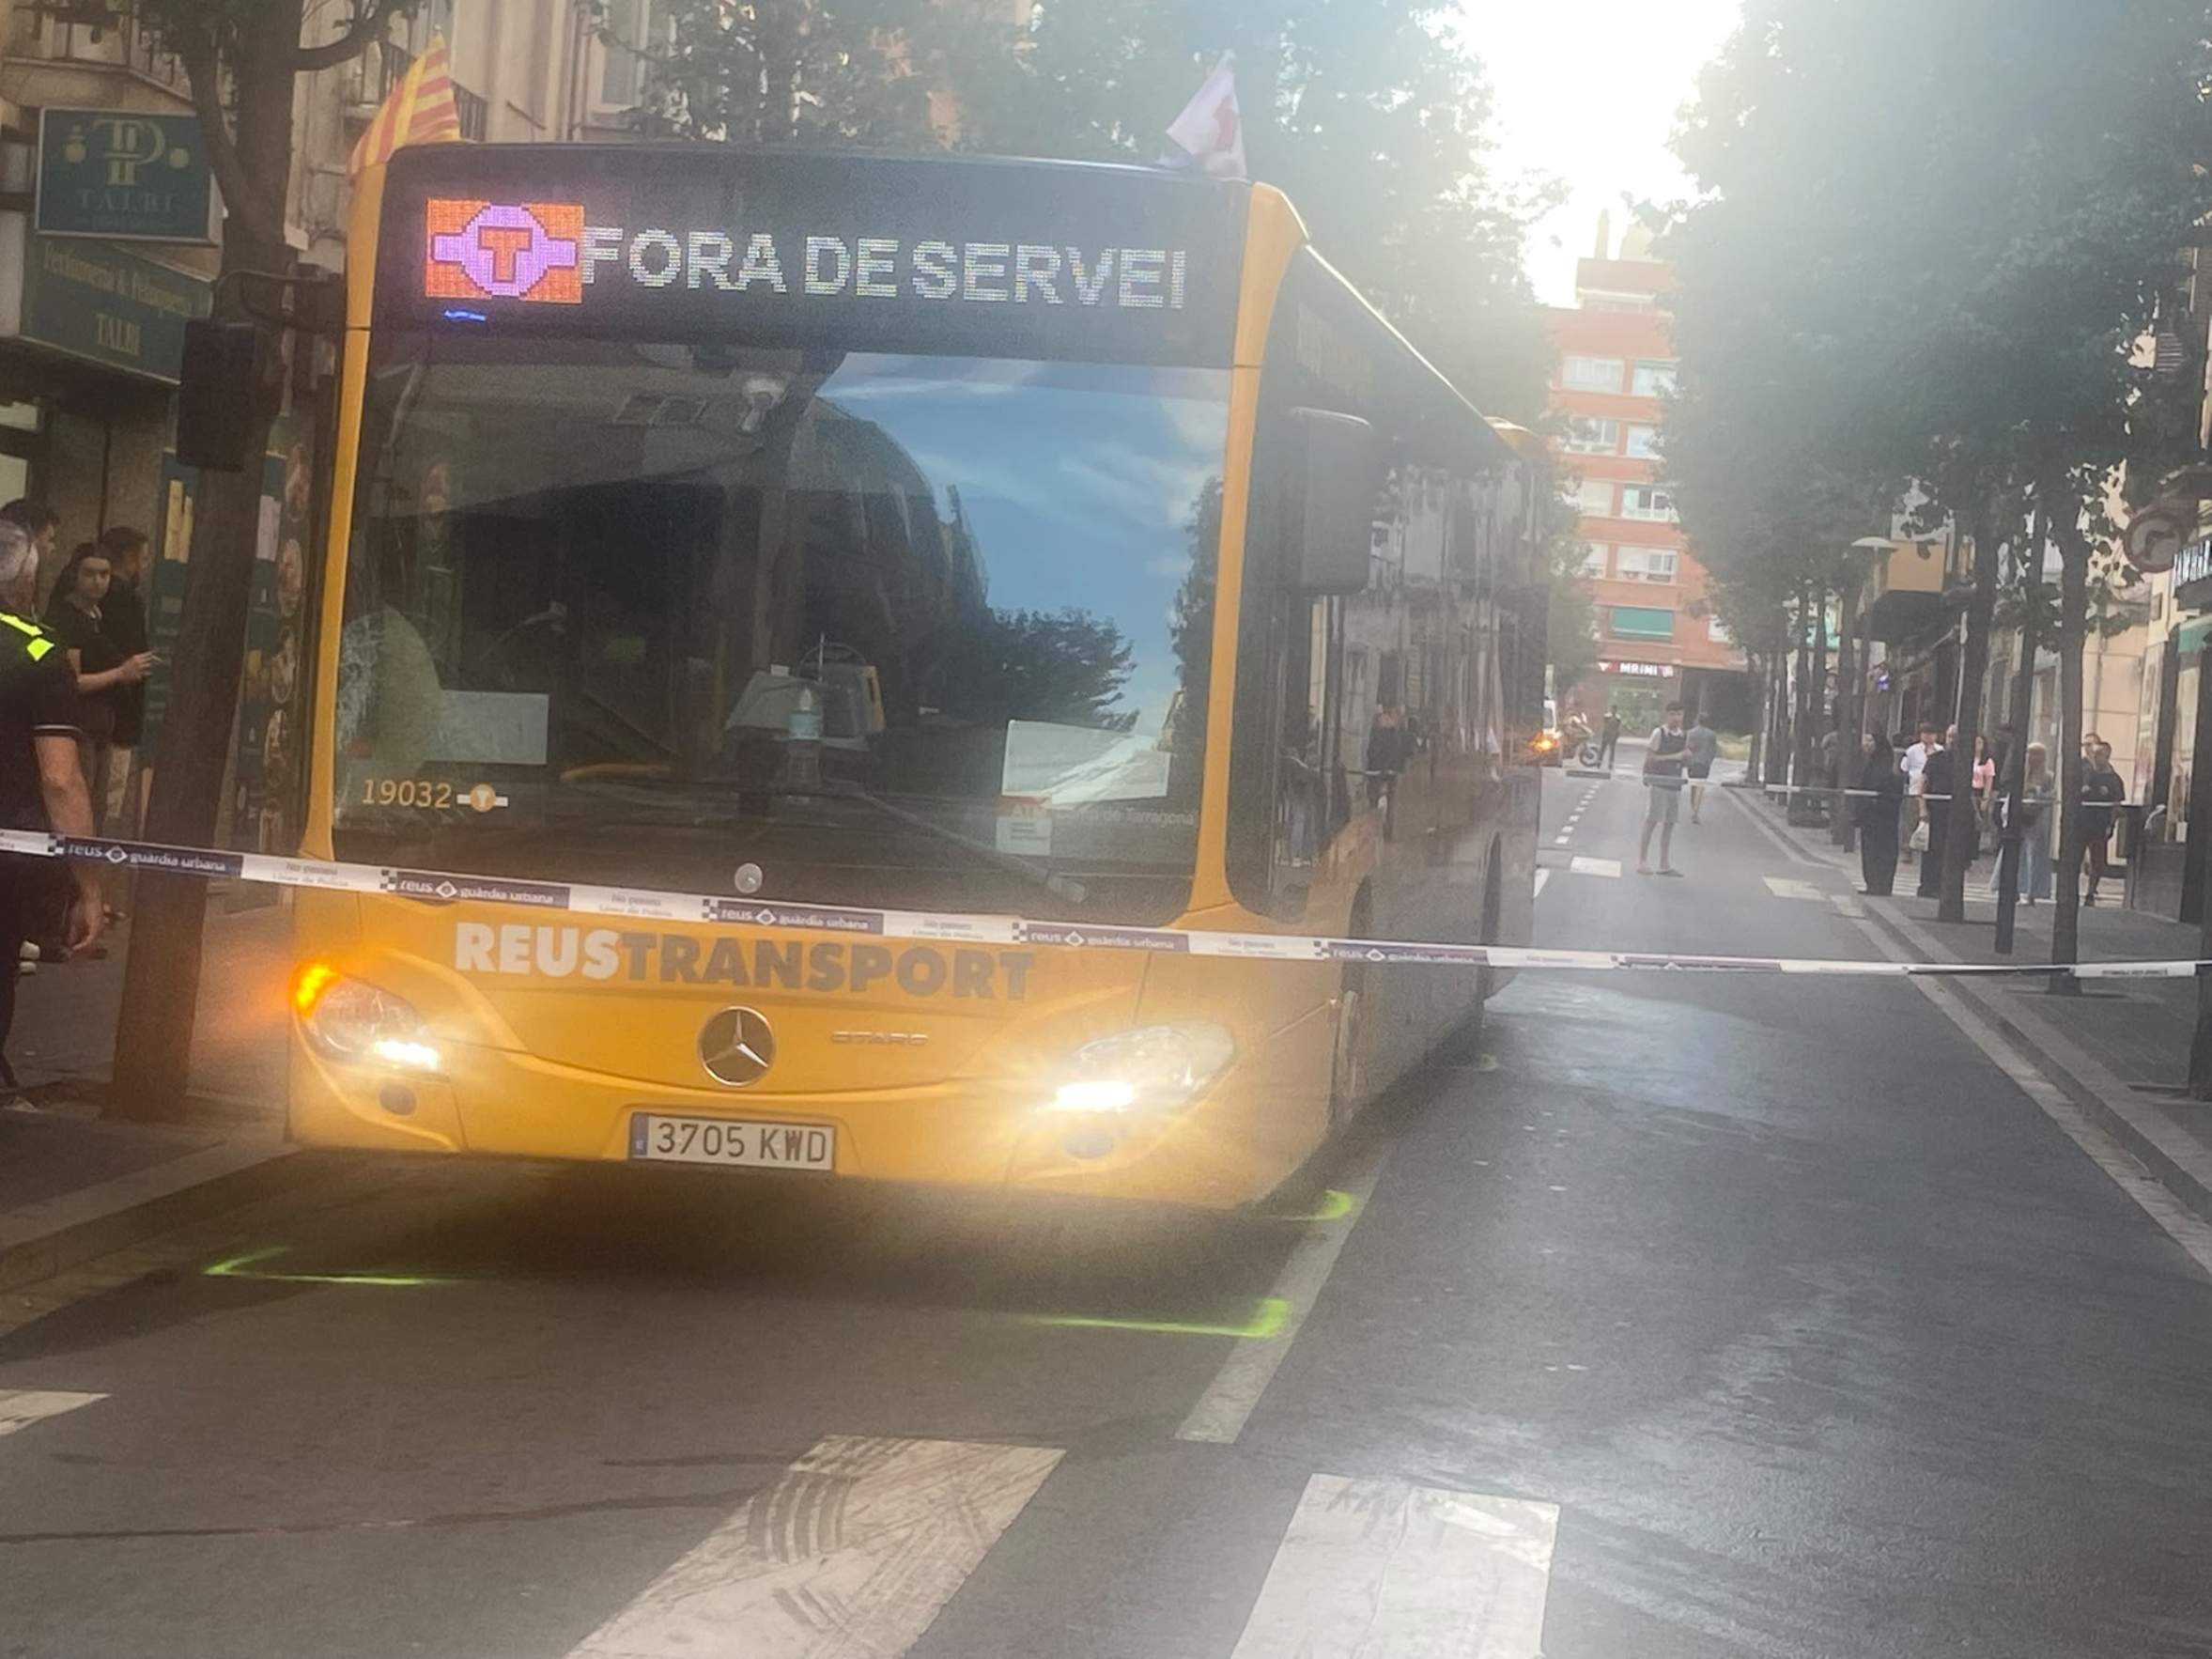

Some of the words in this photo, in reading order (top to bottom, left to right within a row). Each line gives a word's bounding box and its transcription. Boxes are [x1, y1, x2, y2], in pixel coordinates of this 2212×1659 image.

[582, 226, 787, 293] FORA
[805, 236, 899, 298] DE
[913, 240, 1185, 308] SERVEI
[362, 779, 453, 809] 19032
[68, 845, 103, 858] reus
[180, 854, 227, 872] urbana
[399, 879, 433, 892] reus
[509, 891, 554, 904] urbana
[721, 909, 752, 922] reus
[1030, 931, 1061, 942] reus
[657, 1123, 745, 1157] 3705
[759, 1128, 827, 1163] KWD
